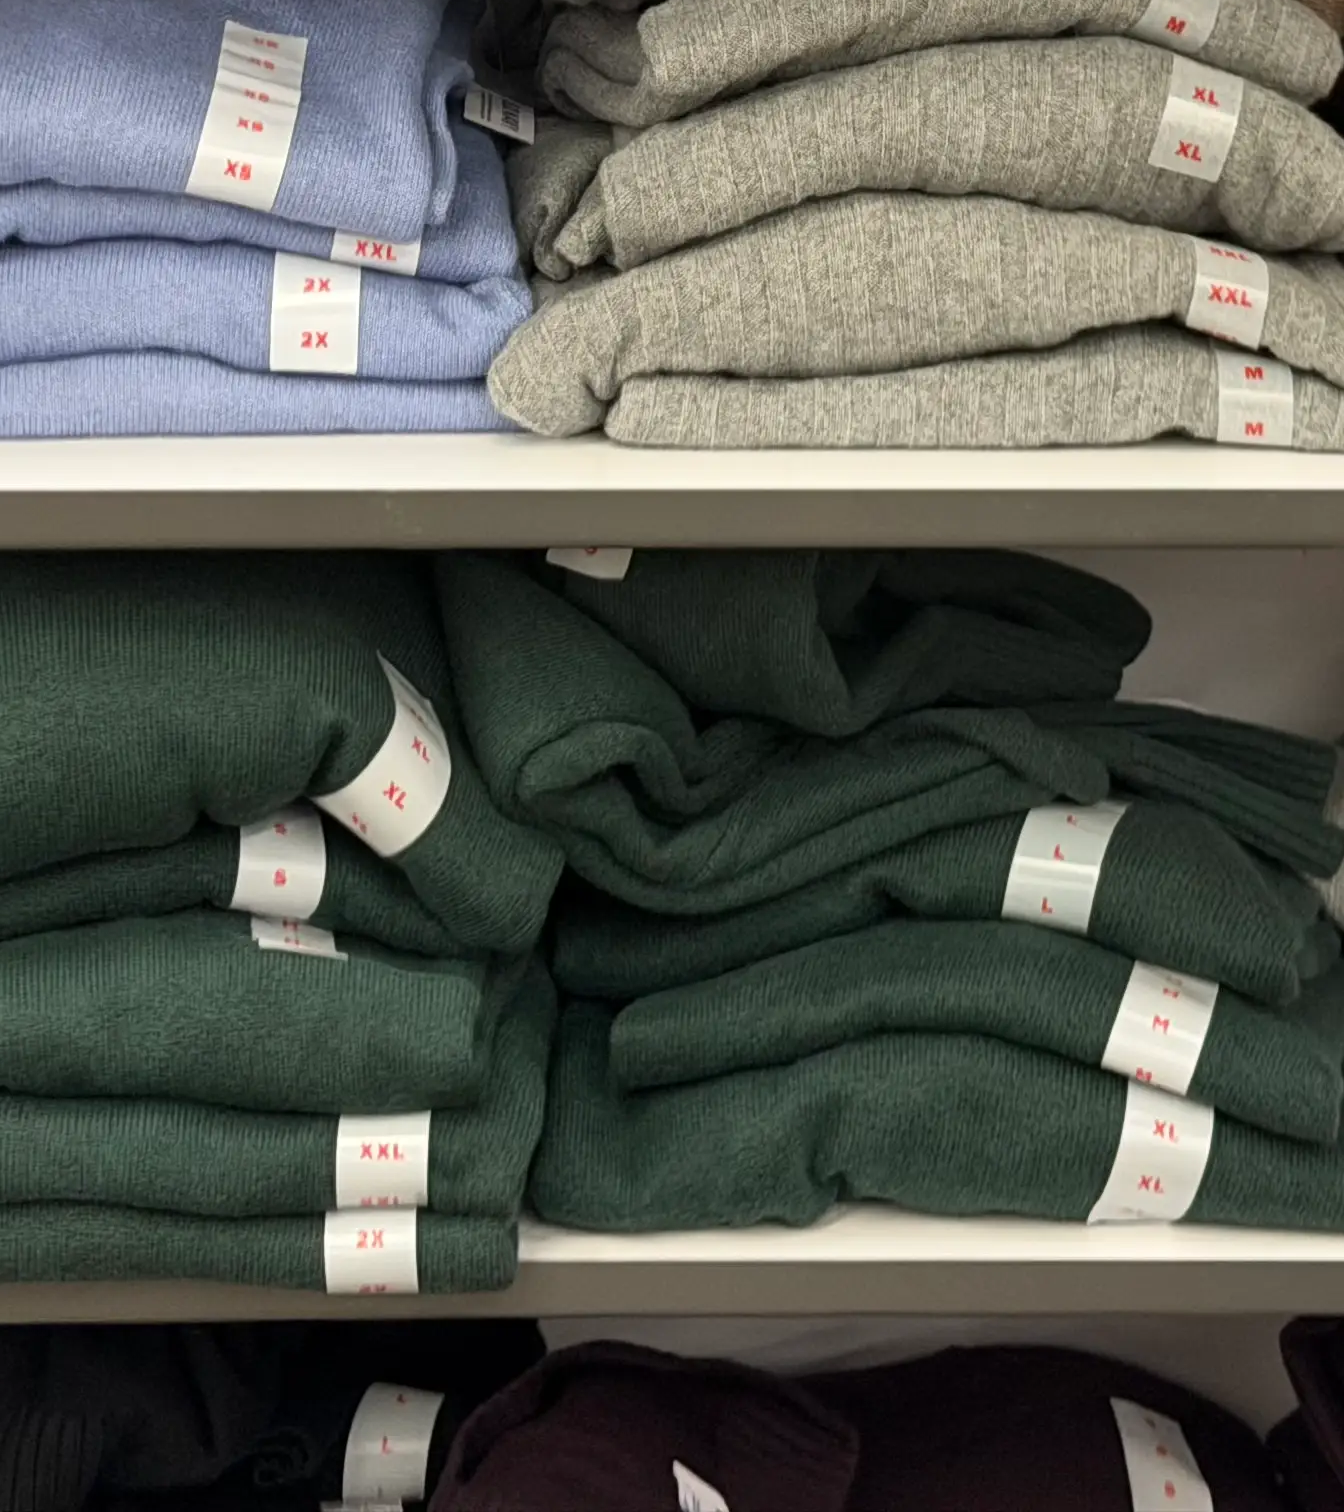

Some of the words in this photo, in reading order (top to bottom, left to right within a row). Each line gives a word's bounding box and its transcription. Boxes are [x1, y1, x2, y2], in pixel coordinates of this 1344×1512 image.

[1164, 15, 1187, 35] M
[1192, 86, 1219, 108] XL
[1176, 139, 1203, 164] XL
[223, 158, 253, 182] XS
[356, 240, 398, 263] XXL
[304, 277, 333, 295] 2X
[1208, 282, 1254, 310] XXL
[301, 330, 331, 351] 2X
[1243, 364, 1264, 381] M
[1243, 421, 1263, 438] M
[409, 735, 431, 765] XL
[381, 780, 406, 811] XL
[1053, 843, 1065, 862] L
[1040, 896, 1054, 914] L
[1152, 1013, 1170, 1035] M
[1152, 1118, 1179, 1143] XL
[359, 1143, 405, 1161] XXL
[1138, 1174, 1165, 1195] XL
[355, 1229, 385, 1249] 2X
